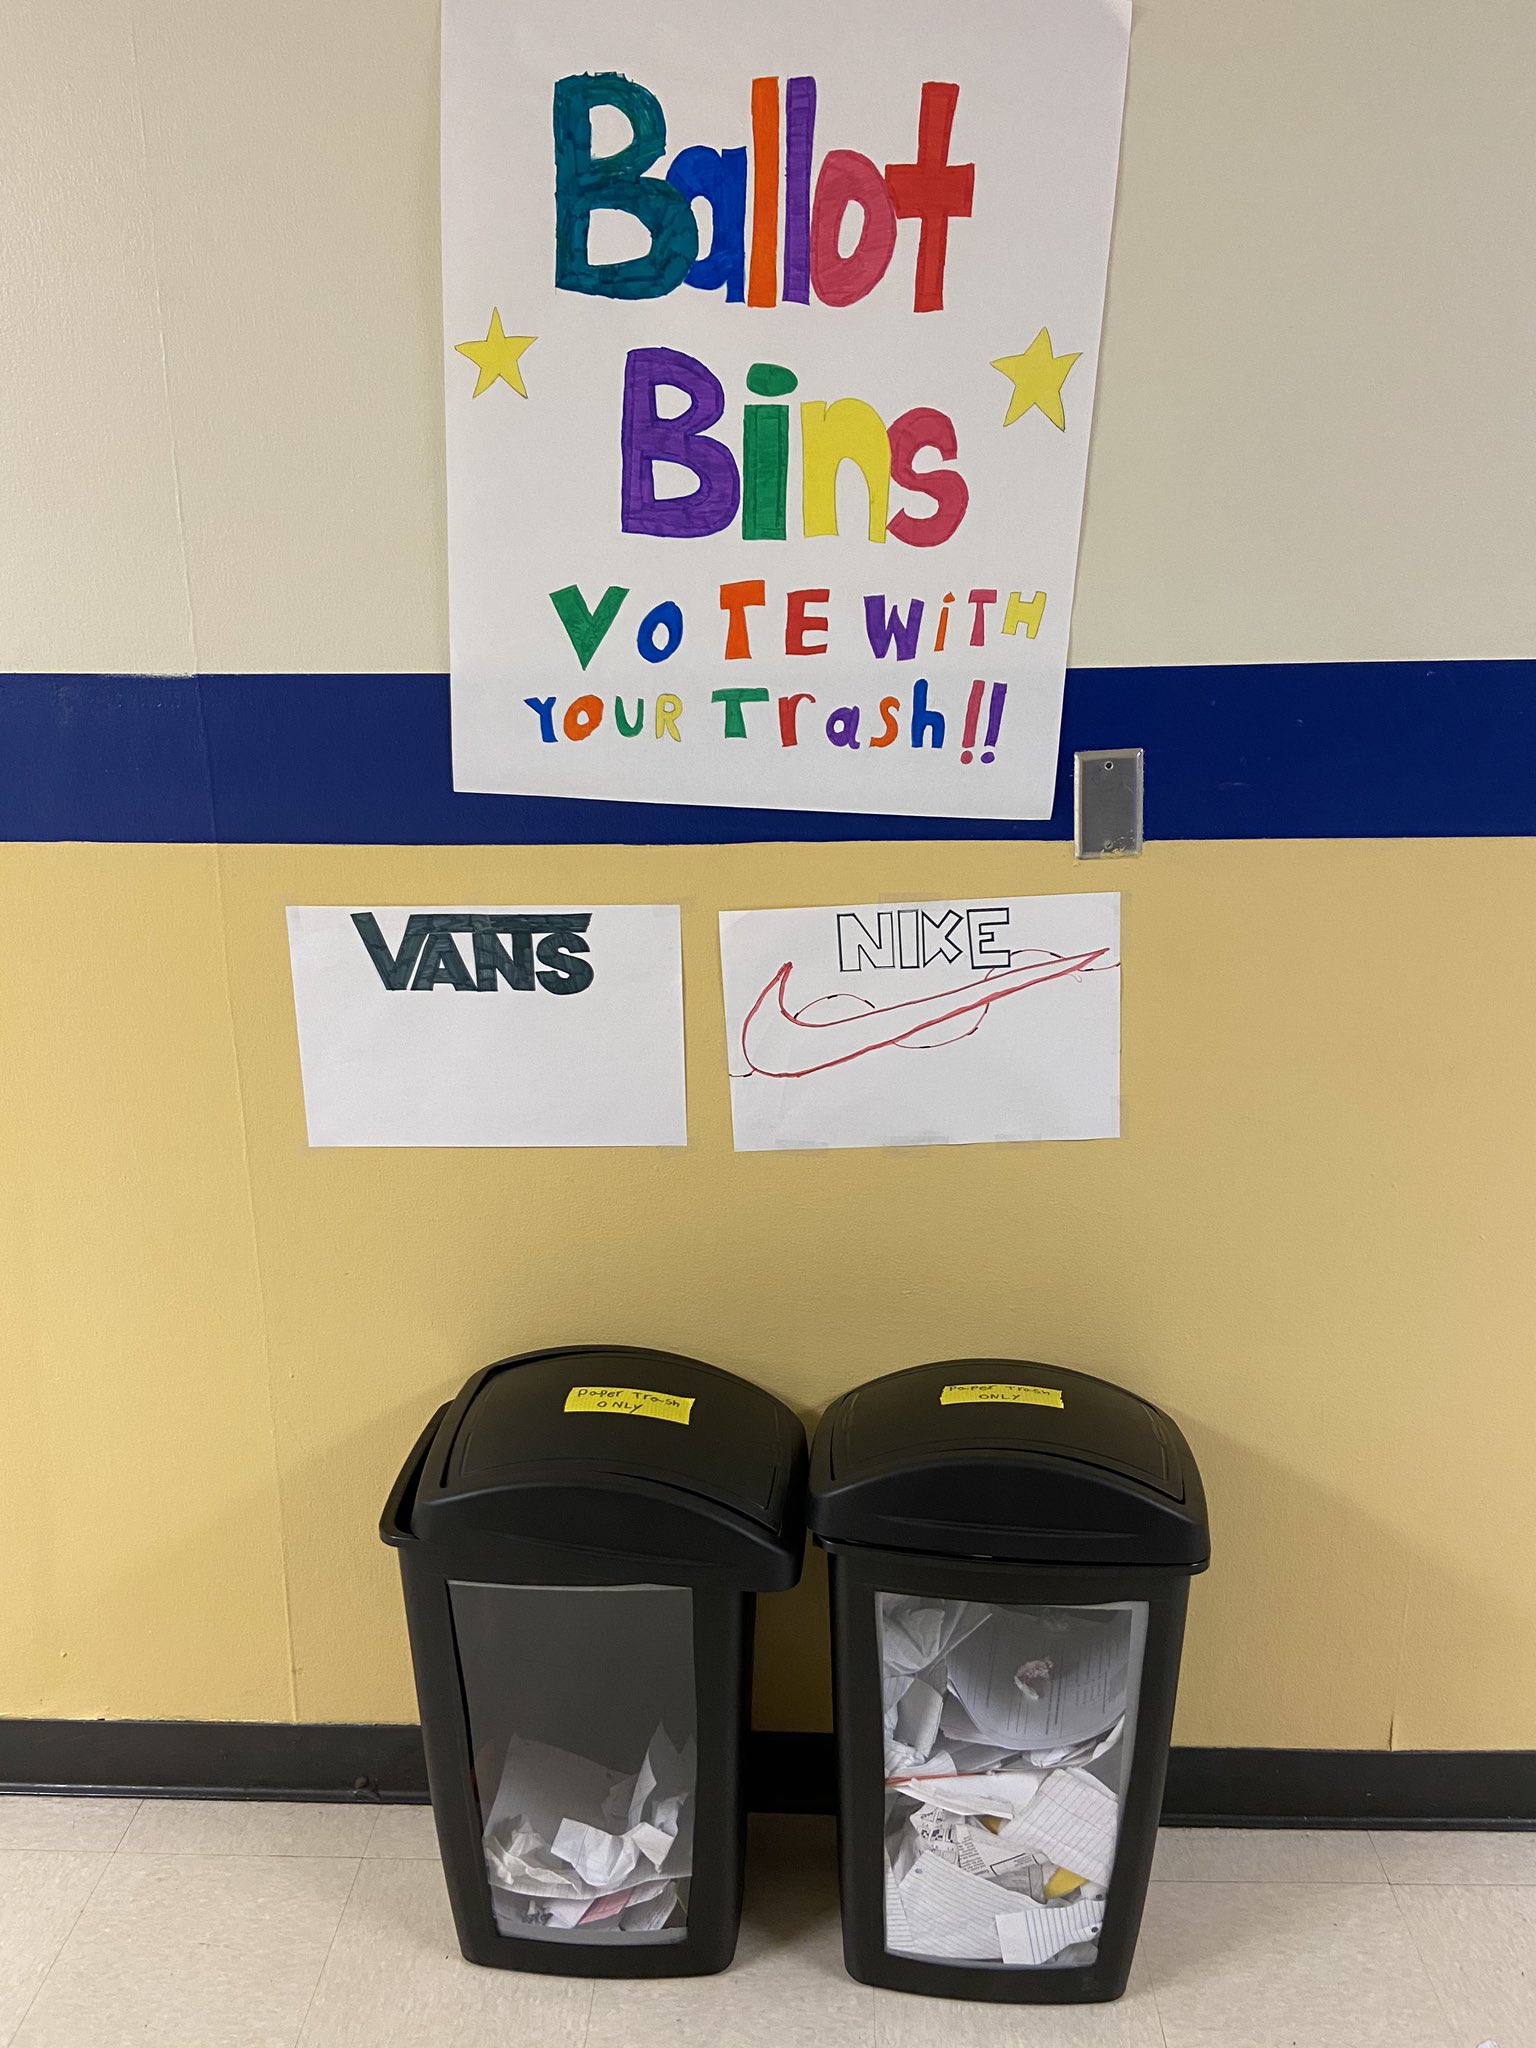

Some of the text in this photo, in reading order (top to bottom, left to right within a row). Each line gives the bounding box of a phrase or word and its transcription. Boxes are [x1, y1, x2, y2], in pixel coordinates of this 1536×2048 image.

[554, 71, 975, 312] Ballot
[621, 347, 969, 547] Bins
[548, 579, 831, 671] VOTE
[523, 678, 1008, 766] YOUR Trash!!
[350, 911, 595, 996] VANS
[837, 907, 1012, 972] NIKE
[596, 1400, 644, 1414] ONLY
[633, 1391, 680, 1407] Trash
[978, 1393, 1022, 1401] ONLY
